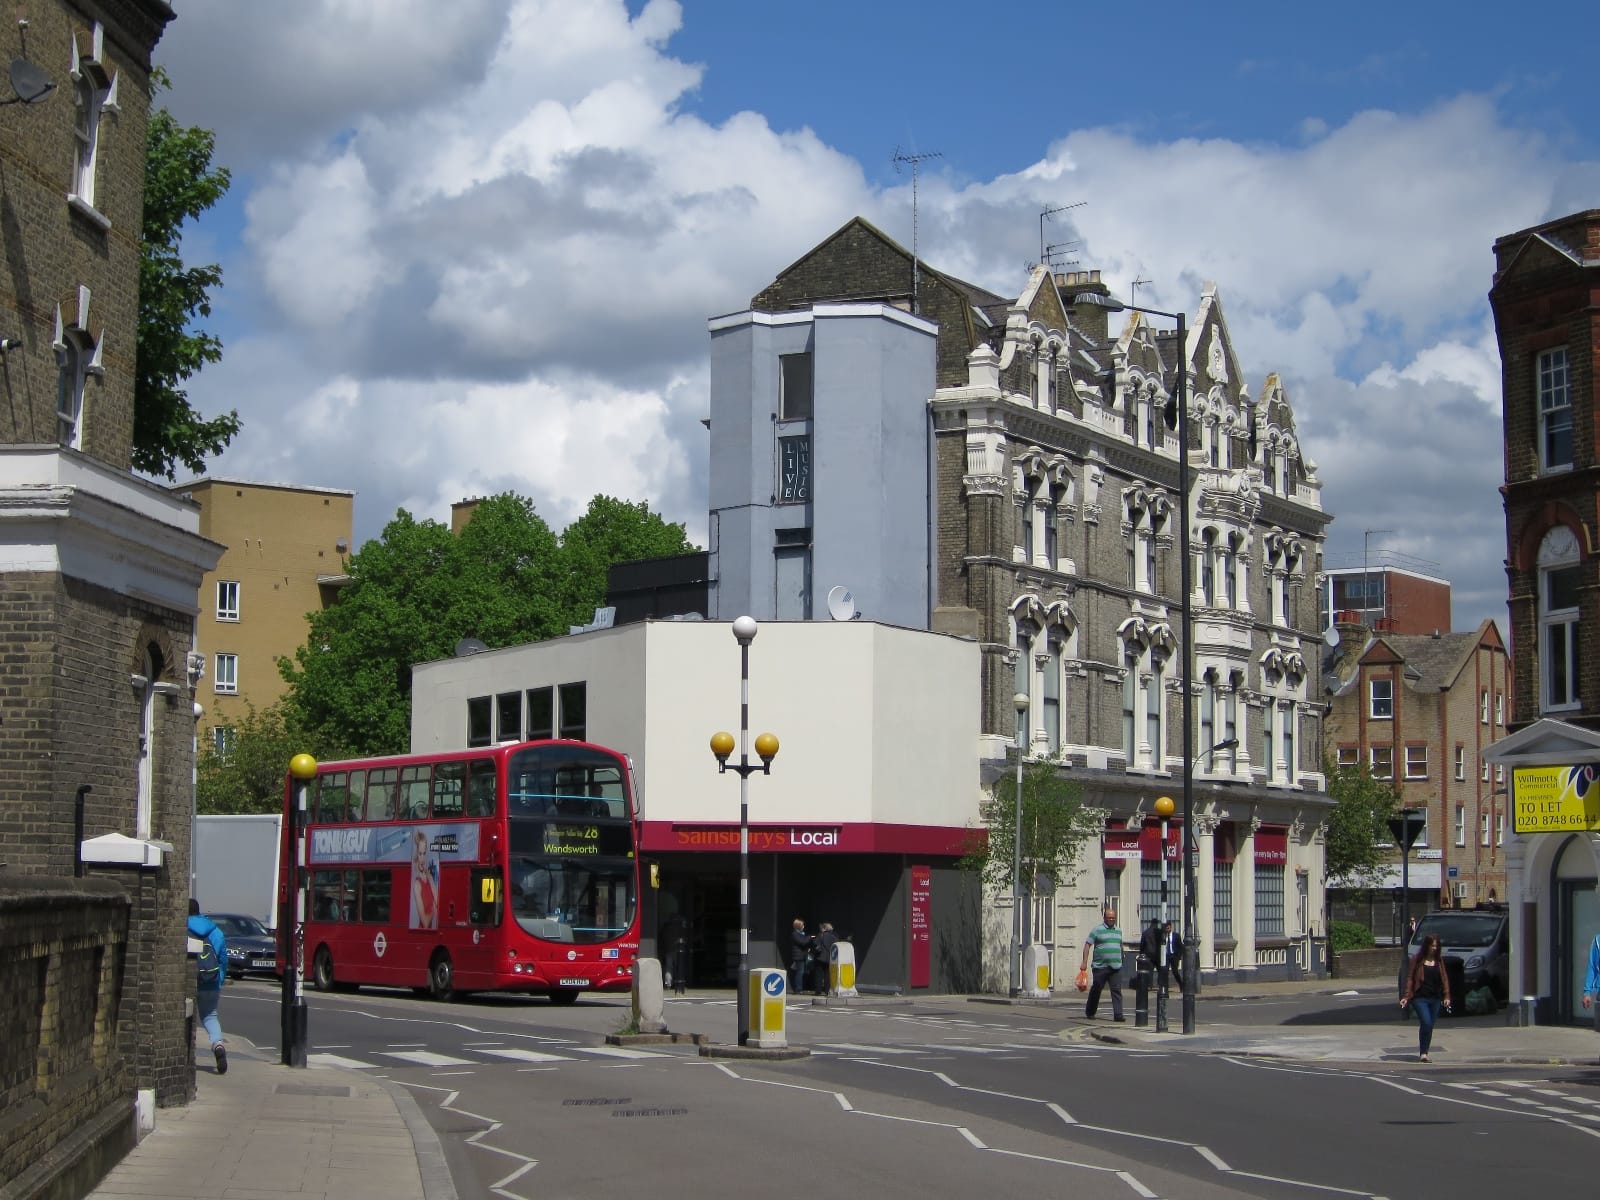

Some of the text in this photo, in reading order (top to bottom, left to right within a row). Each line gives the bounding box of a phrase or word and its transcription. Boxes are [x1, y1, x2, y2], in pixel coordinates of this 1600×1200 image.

[785, 443, 795, 498] LIVE
[799, 441, 809, 498] MUSIC
[1518, 775, 1558, 783] Willmotts
[1520, 801, 1563, 814] TO LET
[1518, 814, 1596, 826] 020 8748 6644
[584, 826, 599, 839] 28
[678, 828, 838, 848] Sainsbrys Local
[543, 844, 599, 854] Wandsworth
[1121, 841, 1139, 849] Local
